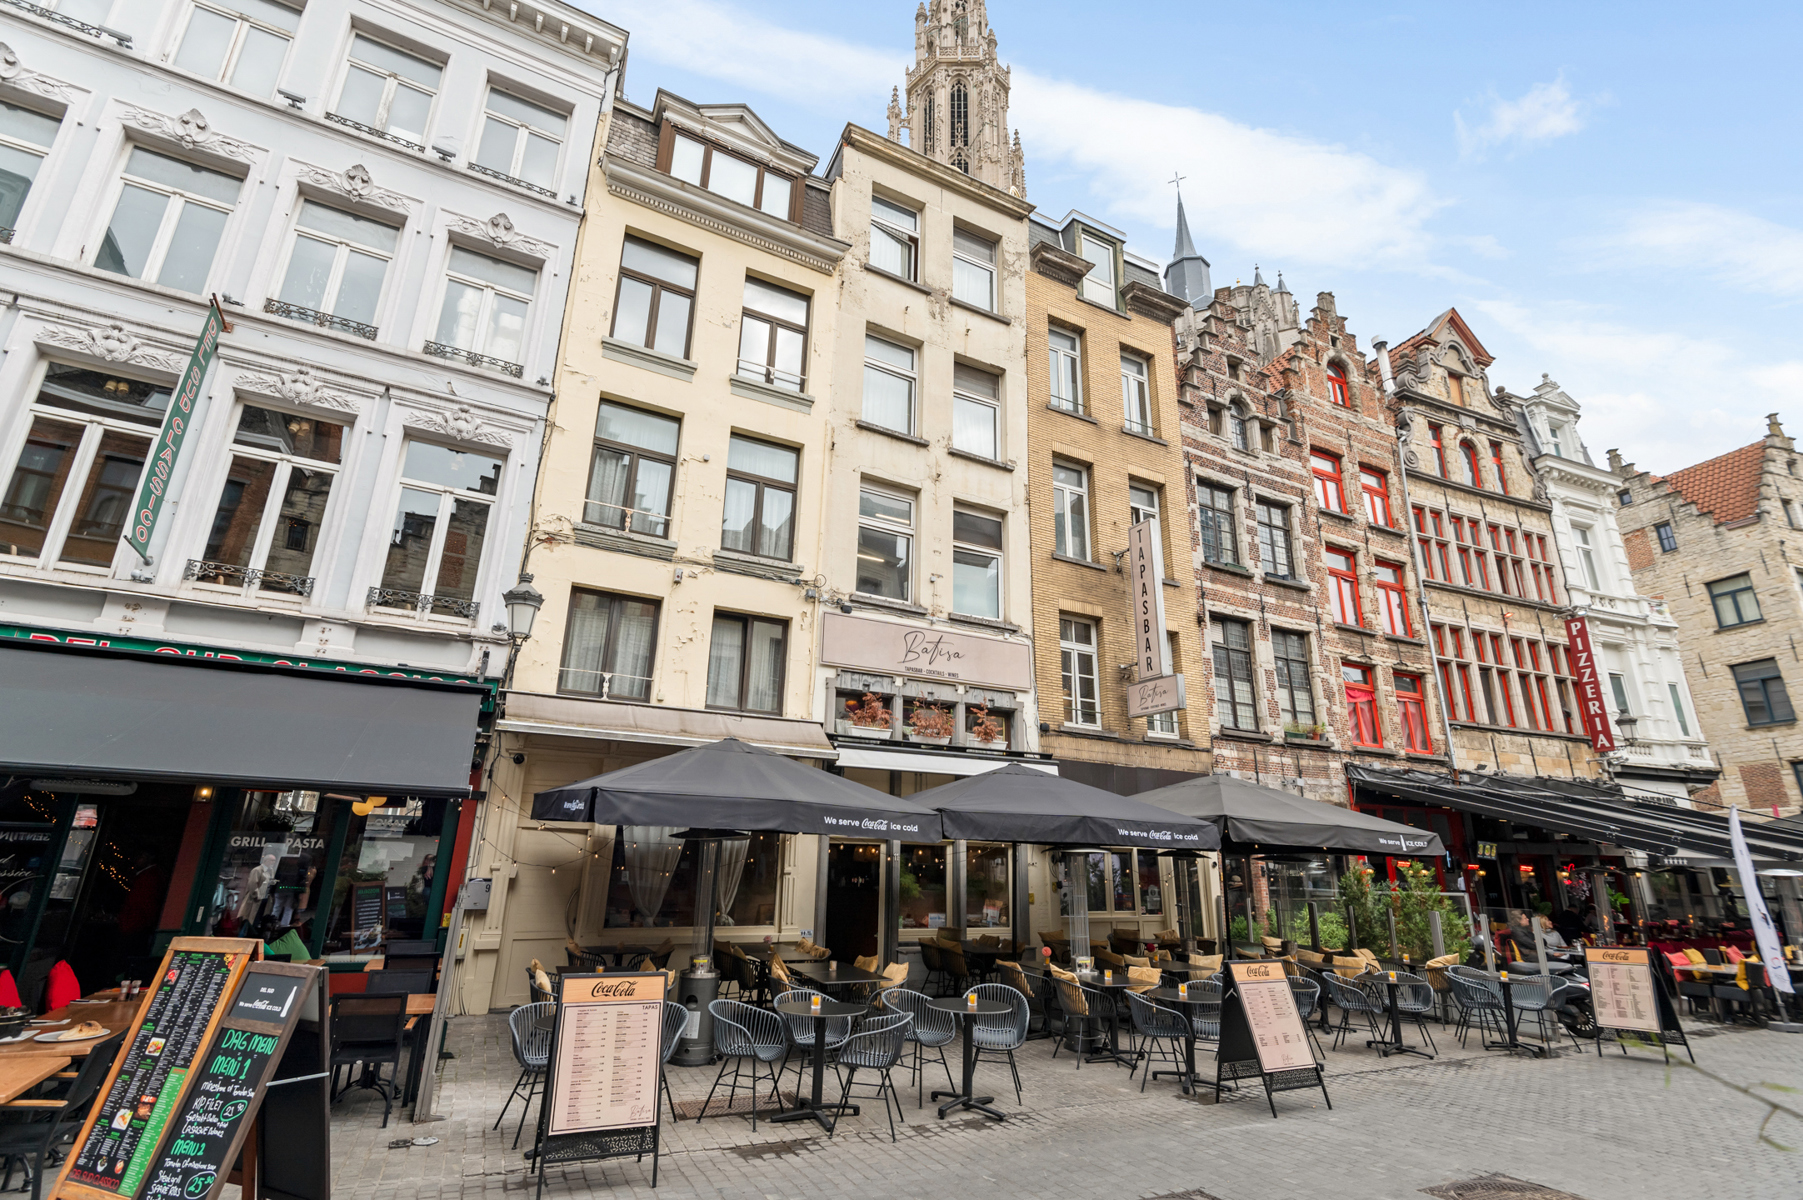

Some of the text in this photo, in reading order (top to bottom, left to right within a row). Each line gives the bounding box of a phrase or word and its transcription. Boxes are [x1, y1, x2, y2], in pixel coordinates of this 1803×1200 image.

[136, 316, 217, 543] DEL SUD CLASSICO
[1137, 528, 1153, 672] TAPASBAR
[904, 665, 923, 674] TAPASBAR
[925, 668, 945, 677] COCKTAILS
[1570, 621, 1611, 749] PIZZERIA
[824, 816, 837, 825] We
[838, 819, 860, 827] serve
[890, 822, 901, 831] ice
[1117, 828, 1129, 836] We
[1129, 830, 1148, 838] serve
[1173, 832, 1183, 840] ice
[1184, 833, 1199, 841] cold
[230, 836, 325, 849] GRILL PASTA
[484, 883, 492, 893] 9
[1602, 951, 1629, 960] Coca-Cola
[1246, 965, 1270, 977] Coca-Cola
[591, 980, 638, 997] Coca-Cola
[221, 1029, 251, 1051] DAG
[197, 1143, 206, 1156] 2
[70, 1169, 82, 1180] DEL
[81, 1171, 94, 1183] SUD
[187, 1176, 206, 1193] 25
